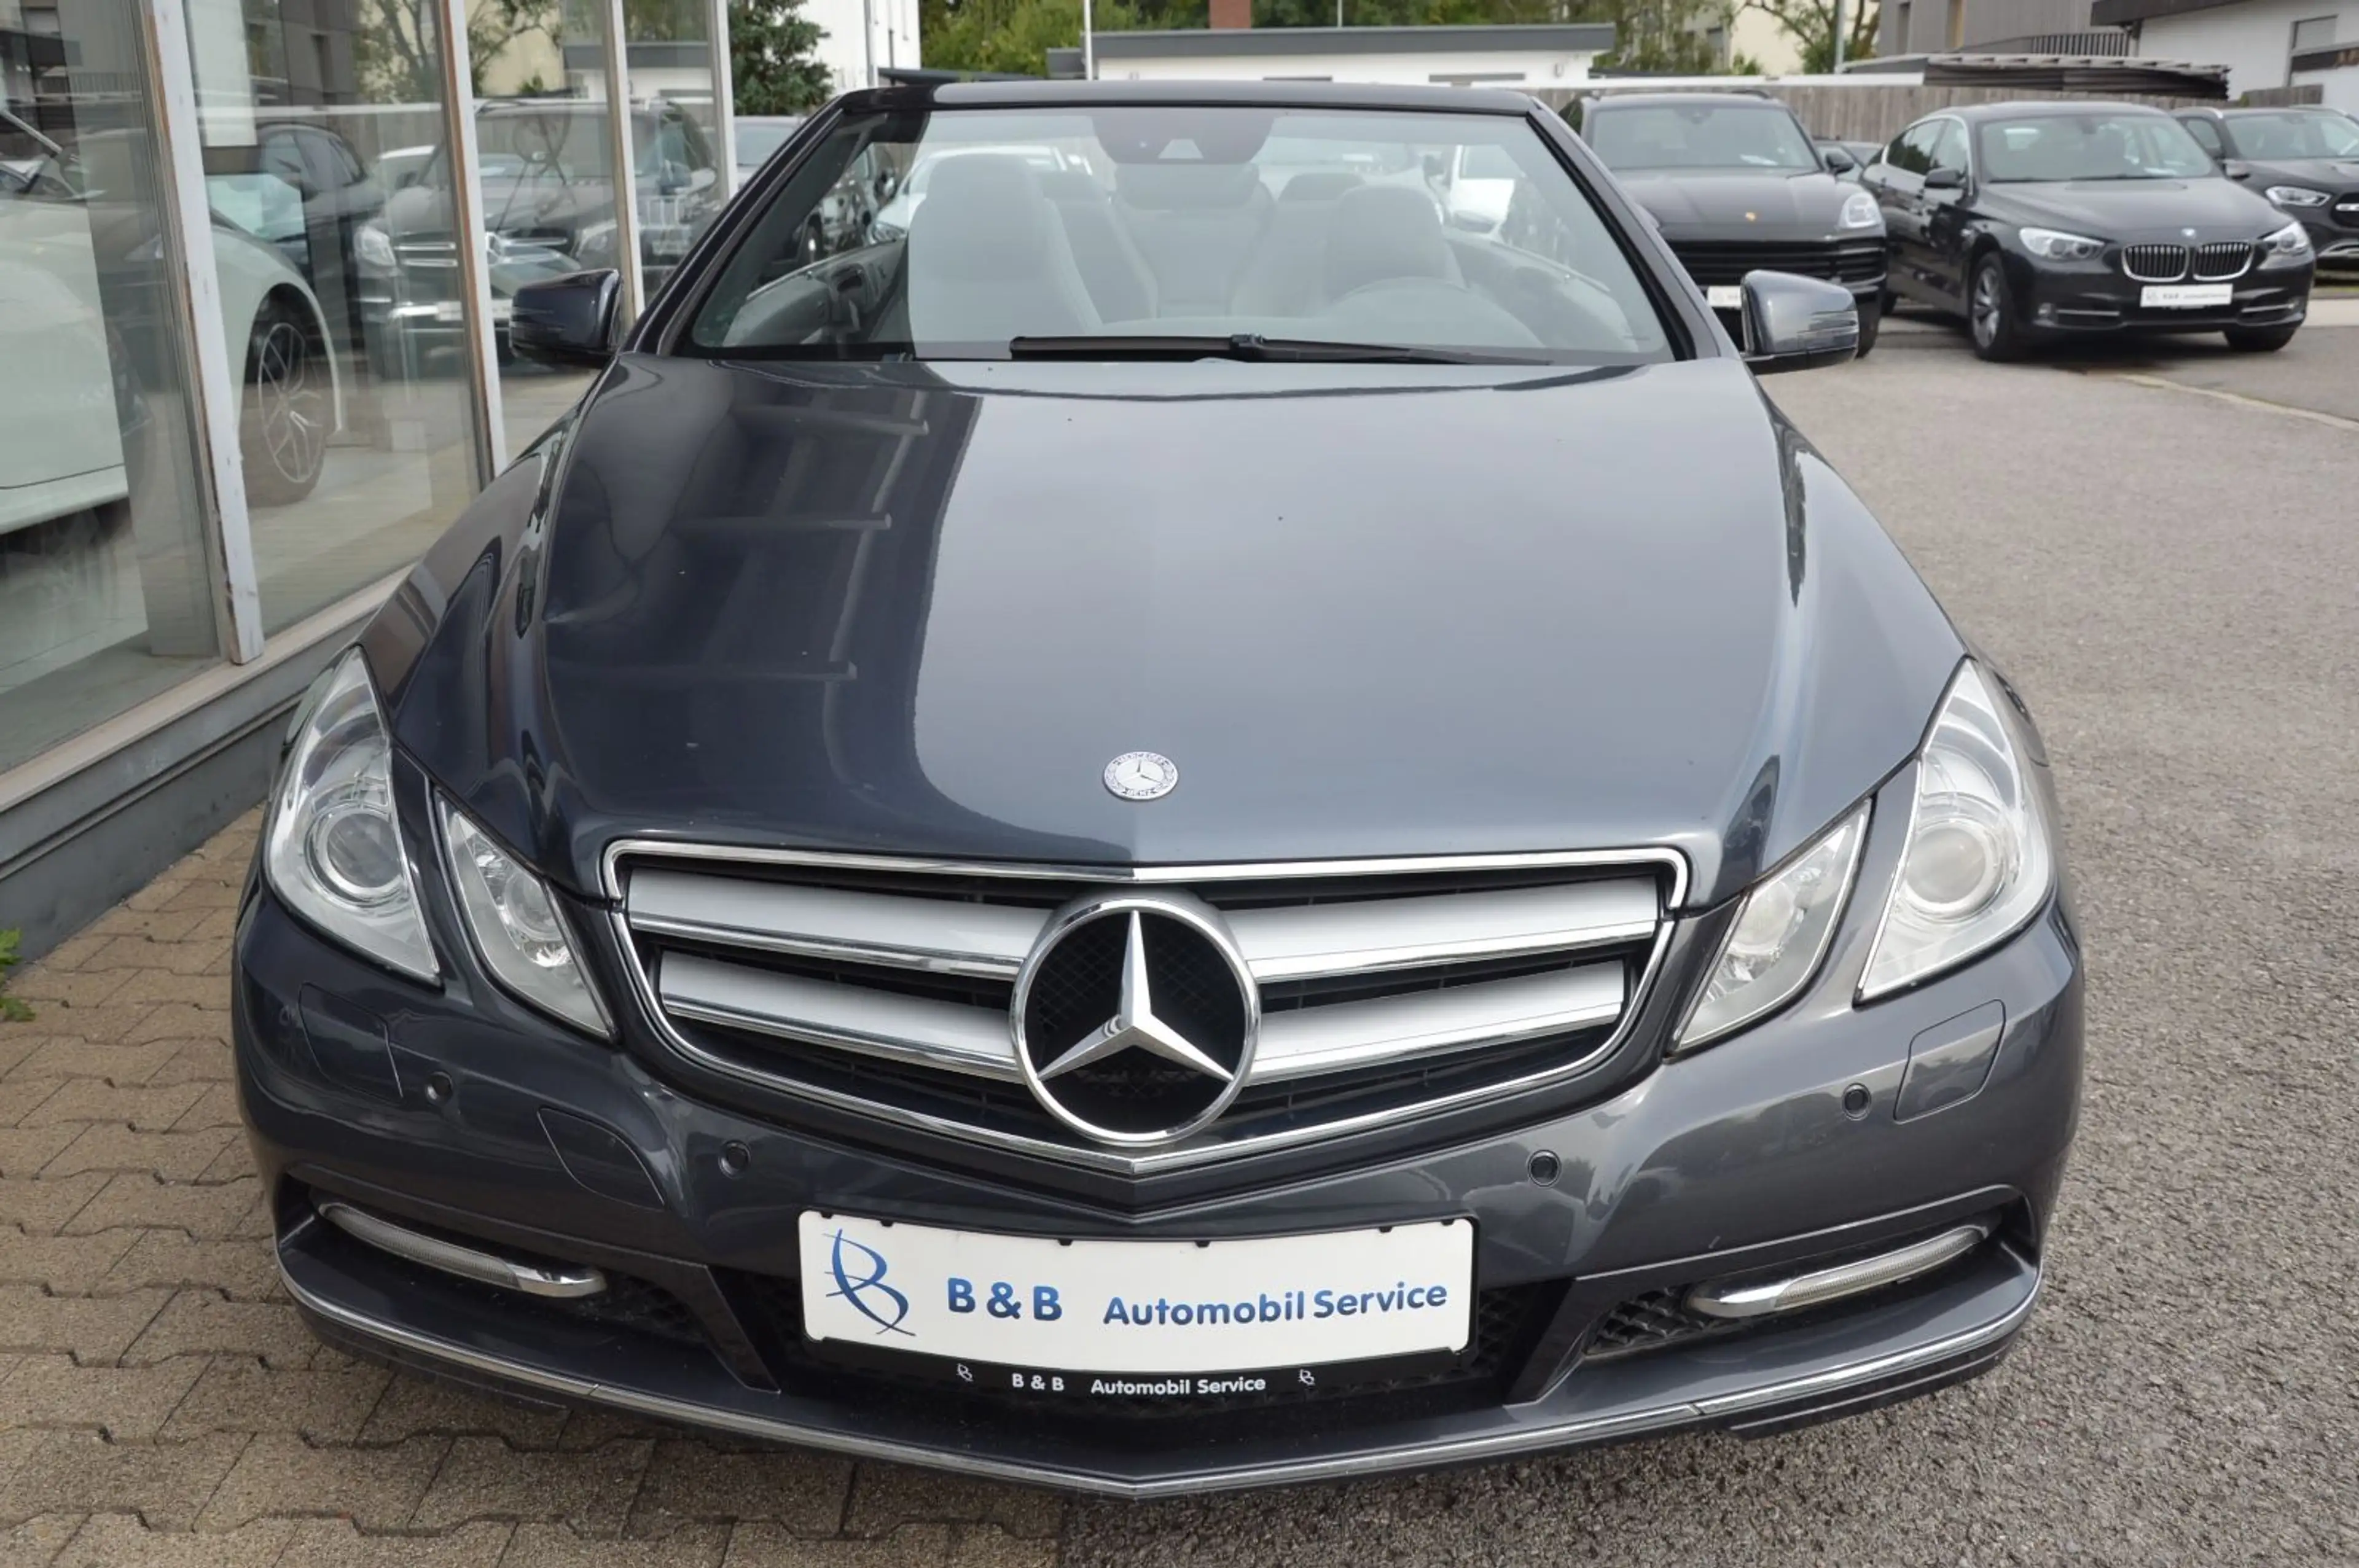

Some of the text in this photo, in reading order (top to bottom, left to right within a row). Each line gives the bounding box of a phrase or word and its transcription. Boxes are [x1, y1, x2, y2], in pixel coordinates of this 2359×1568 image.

[947, 1277, 1448, 1325] B & B Automobil Service
[1012, 1373, 1266, 1395] B & B Automobil Service
